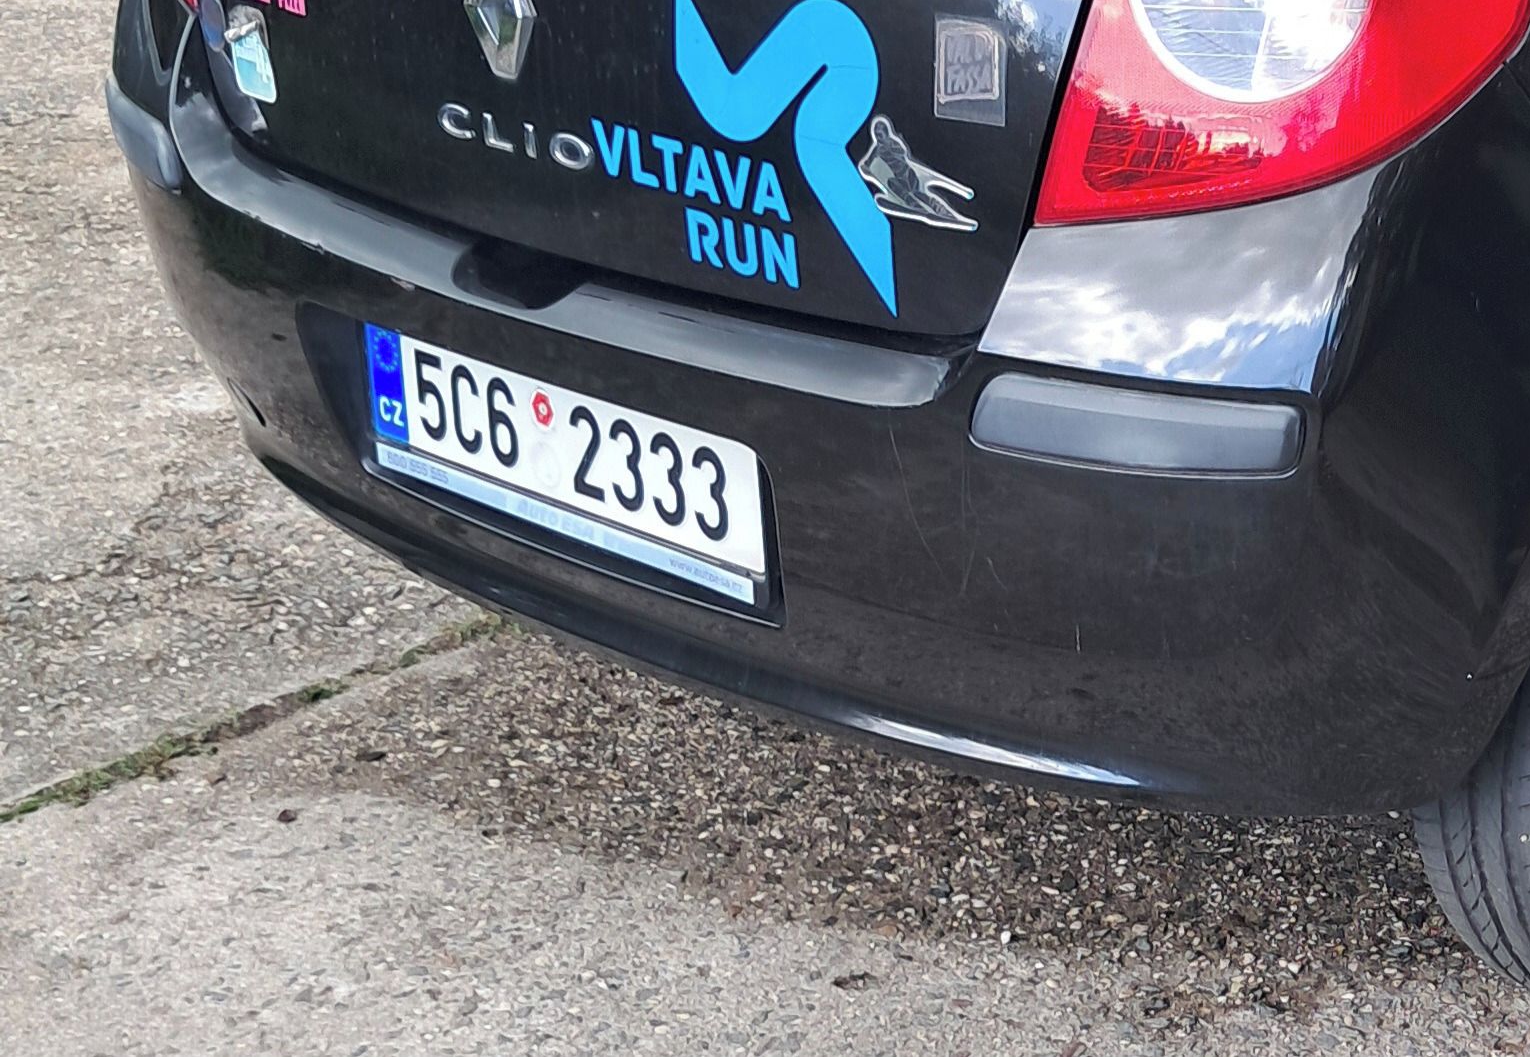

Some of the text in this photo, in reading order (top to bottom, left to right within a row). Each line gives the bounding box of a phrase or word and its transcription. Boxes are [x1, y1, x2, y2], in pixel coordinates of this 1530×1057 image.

[437, 102, 596, 171] CLIO
[591, 117, 794, 223] VLTAVA
[684, 206, 800, 290] RUN
[379, 399, 406, 428] CZ
[413, 348, 730, 542] 5C6 2333
